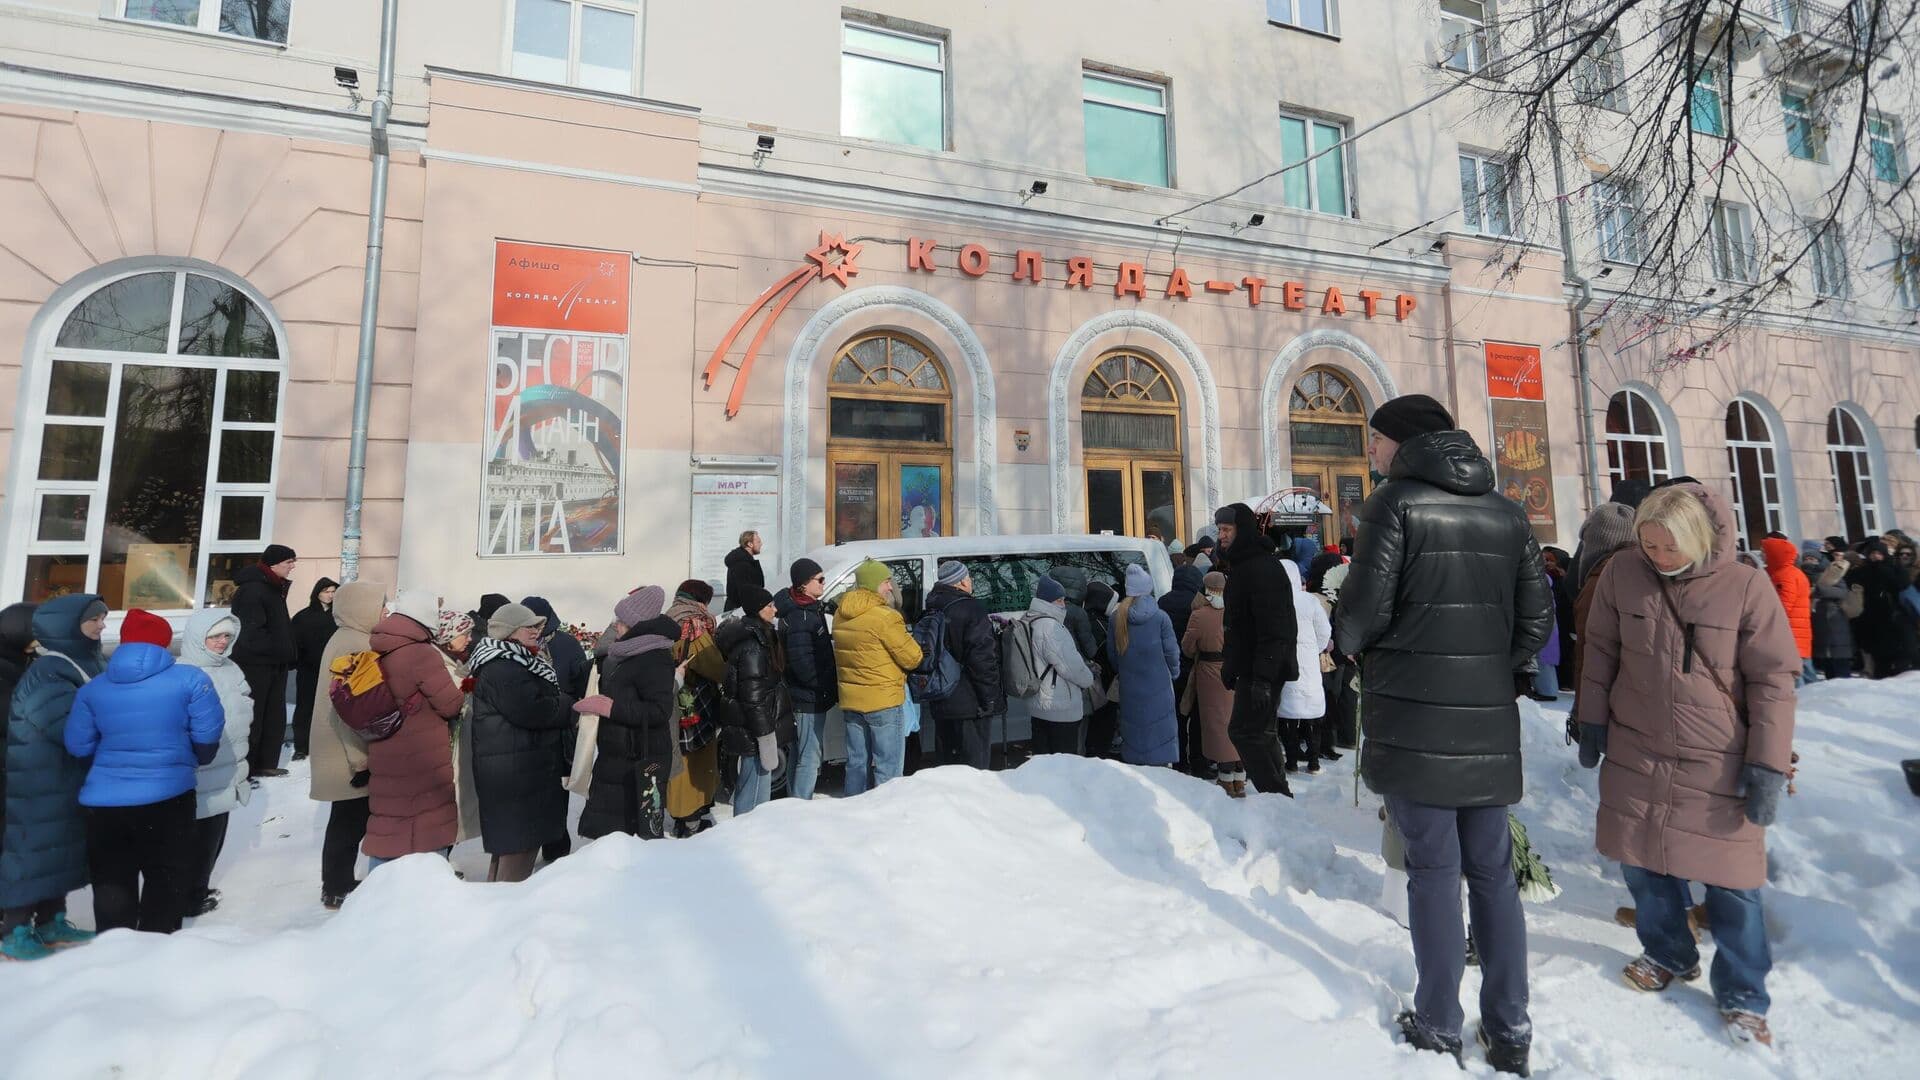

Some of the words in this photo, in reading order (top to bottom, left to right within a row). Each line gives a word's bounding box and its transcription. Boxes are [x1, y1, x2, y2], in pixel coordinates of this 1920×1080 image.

[509, 257, 560, 271] Афиша
[506, 291, 558, 302] КОЛЯДА
[577, 296, 618, 305] ТЕАТР
[718, 481, 748, 489] МАРТ
